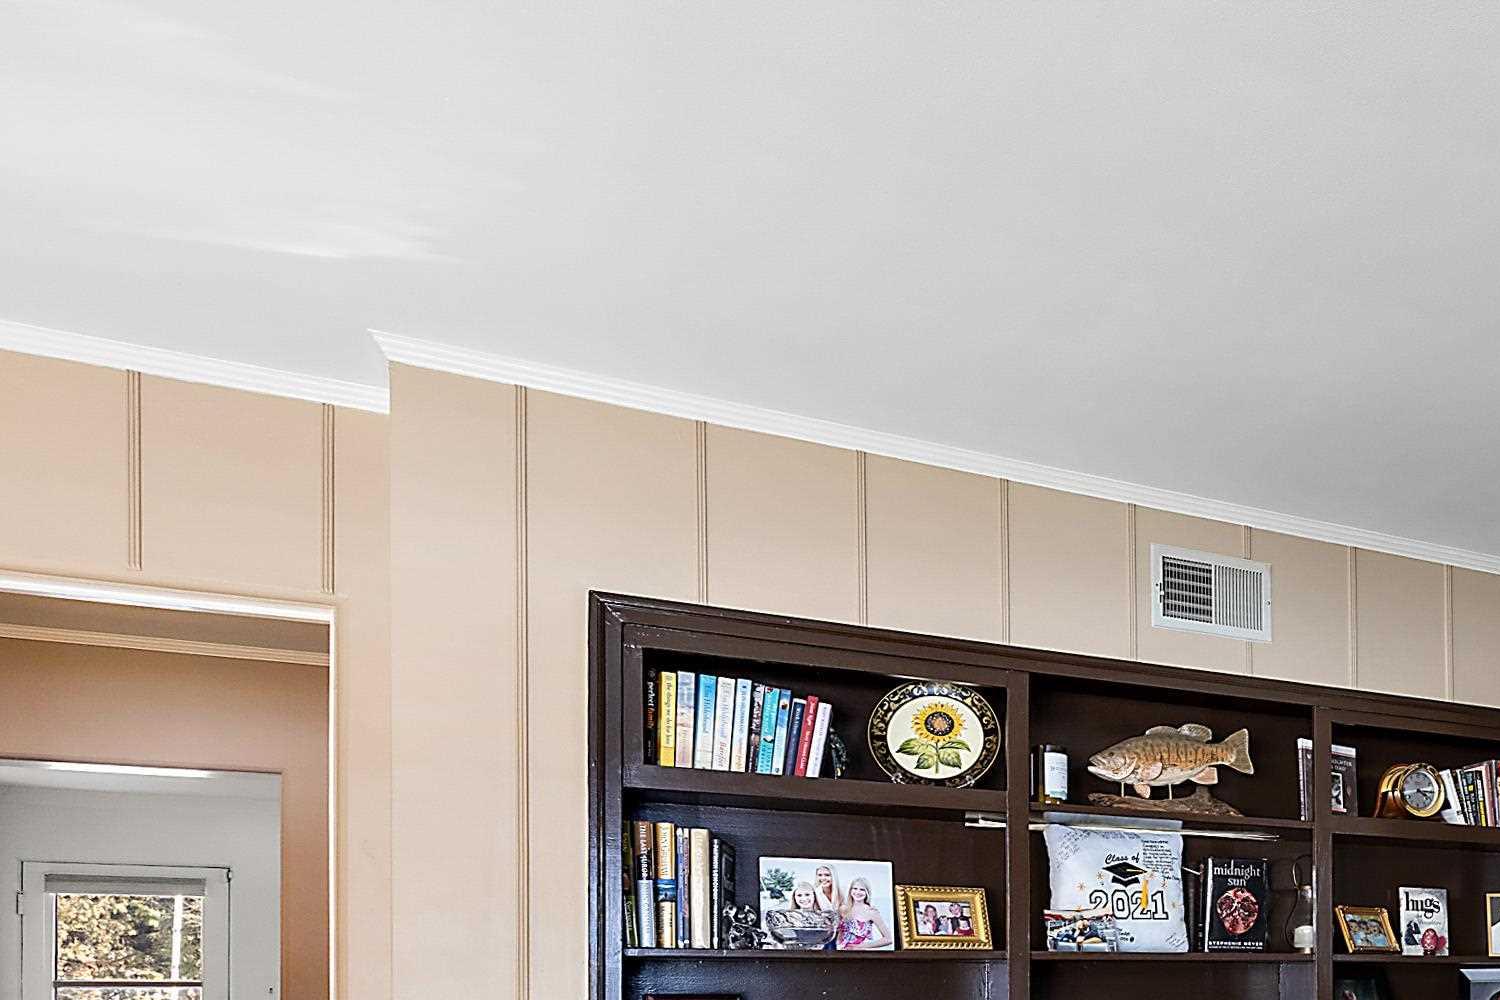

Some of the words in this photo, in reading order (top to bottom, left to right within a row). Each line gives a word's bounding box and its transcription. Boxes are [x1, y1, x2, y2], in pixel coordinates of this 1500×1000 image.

[1105, 854, 1128, 864] Class
[1132, 853, 1140, 863] of
[1213, 861, 1261, 879] midnight
[1227, 878, 1247, 887] sun
[1089, 889, 1169, 920] 2021
[1404, 891, 1441, 919] hugs
